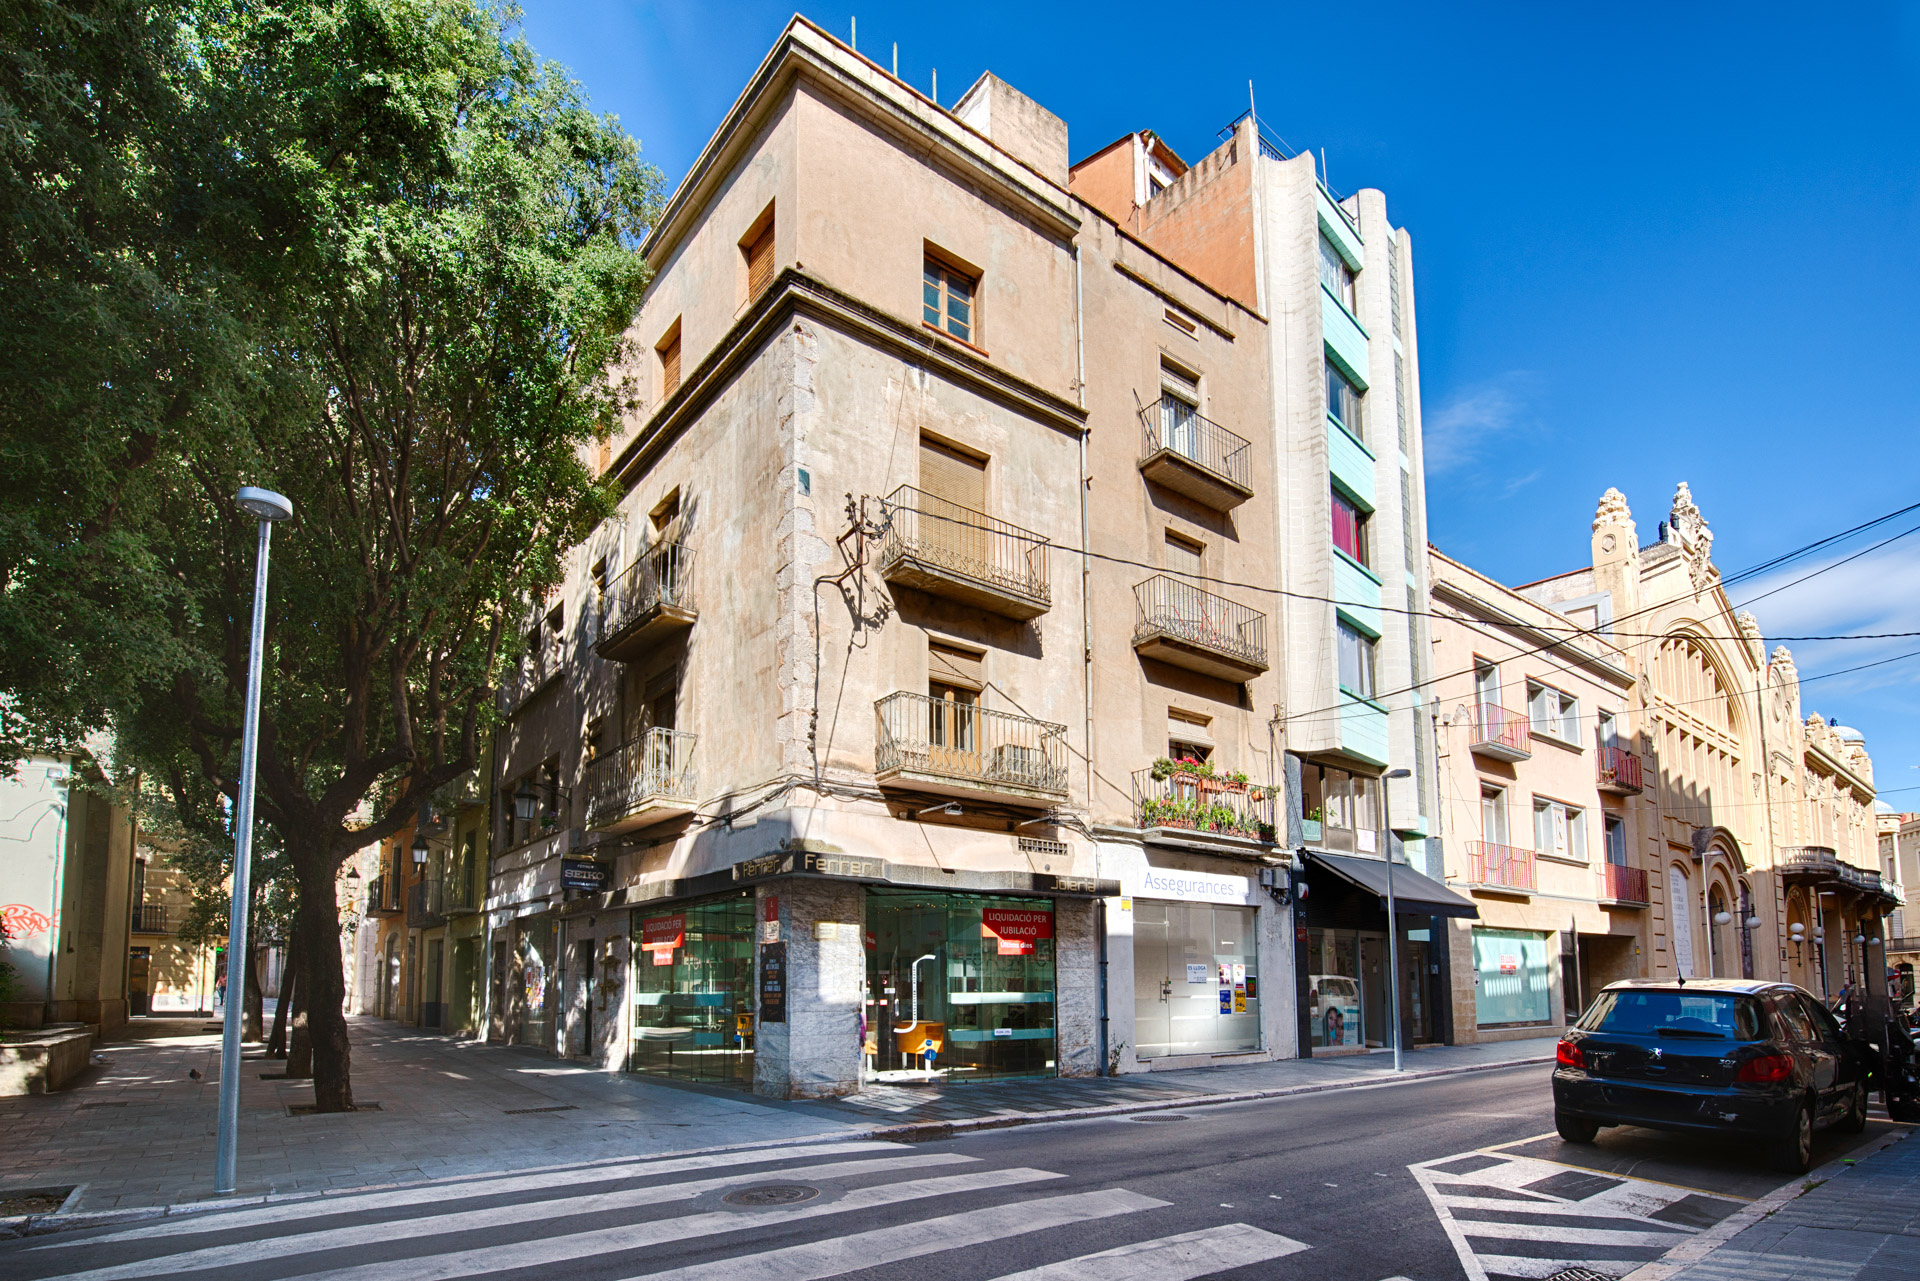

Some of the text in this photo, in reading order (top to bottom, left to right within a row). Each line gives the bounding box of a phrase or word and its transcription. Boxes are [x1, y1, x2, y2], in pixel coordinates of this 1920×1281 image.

[743, 858, 780, 878] Ferrer
[804, 853, 872, 874] Ferrer
[564, 869, 606, 880] SEIKO
[1050, 876, 1096, 893] Joieria
[1144, 872, 1235, 896] Assegurances
[988, 912, 1047, 923] LIQUIDACIÓ PER
[646, 918, 682, 933] LIQUIDACIÓ PER
[1000, 925, 1037, 936] JUBILACIÓ
[1019, 941, 1033, 949] dies
